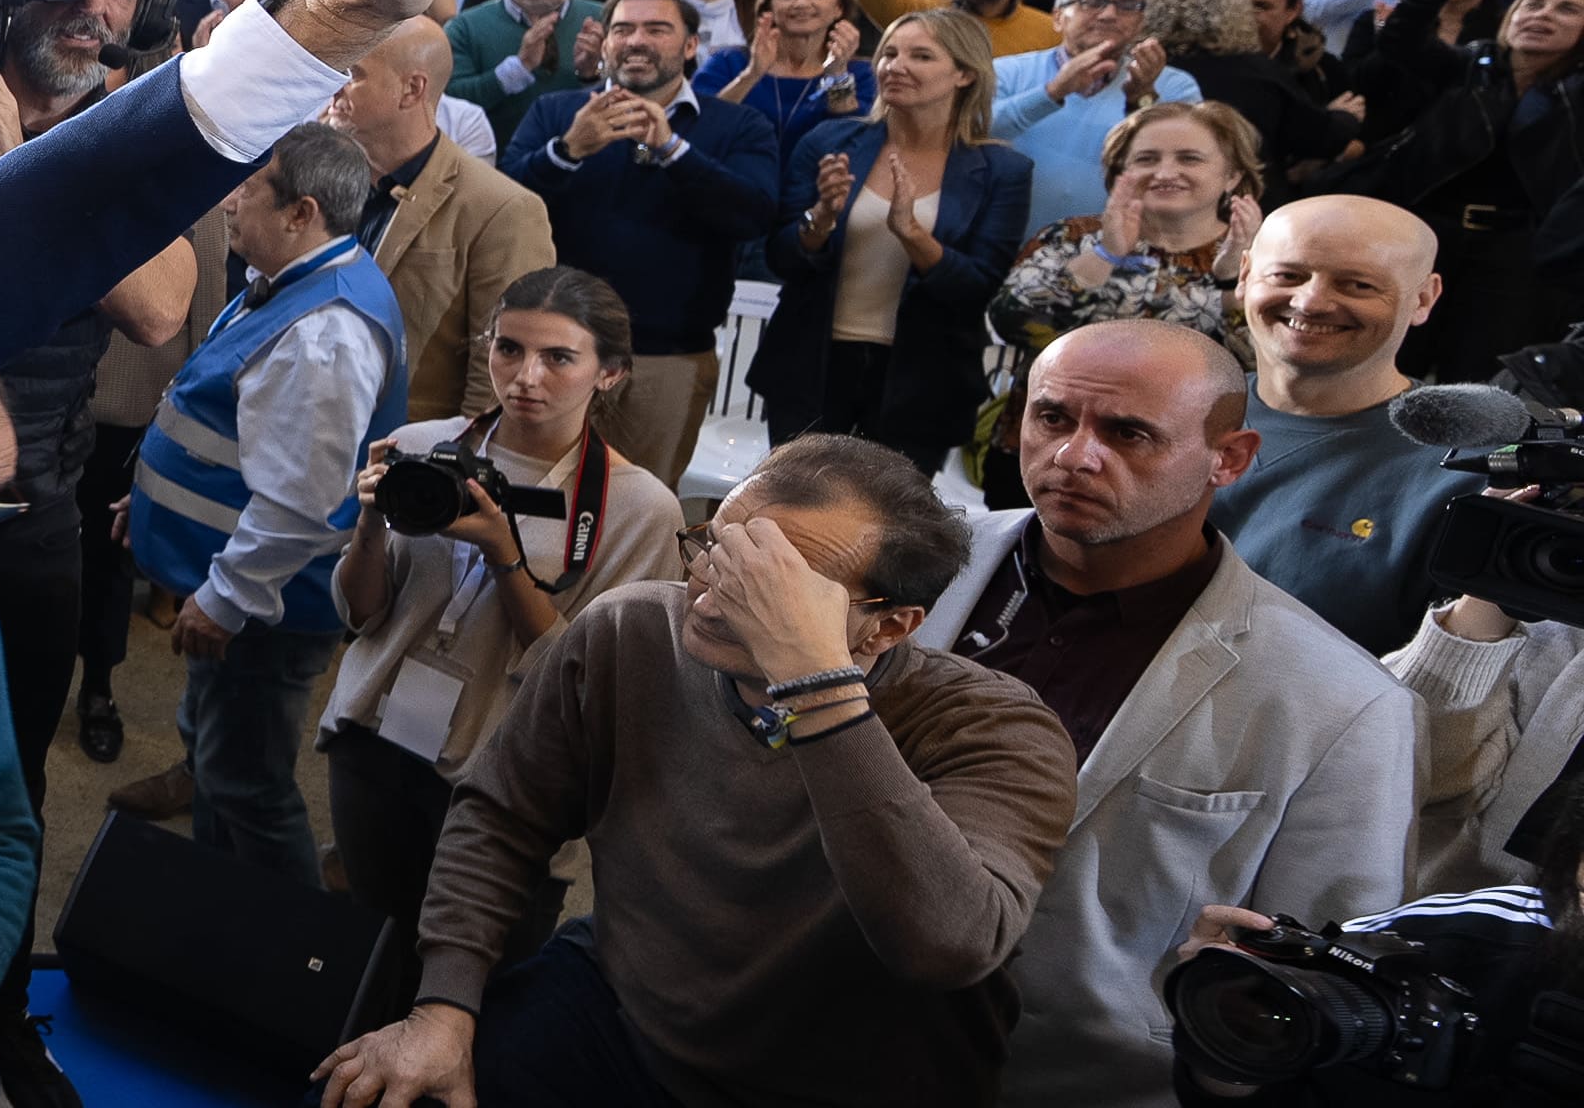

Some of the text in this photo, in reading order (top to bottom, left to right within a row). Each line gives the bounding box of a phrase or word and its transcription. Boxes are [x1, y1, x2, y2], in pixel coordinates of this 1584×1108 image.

[432, 452, 457, 461] Canon
[573, 511, 594, 561] Canon
[1328, 946, 1375, 973] Nikon
